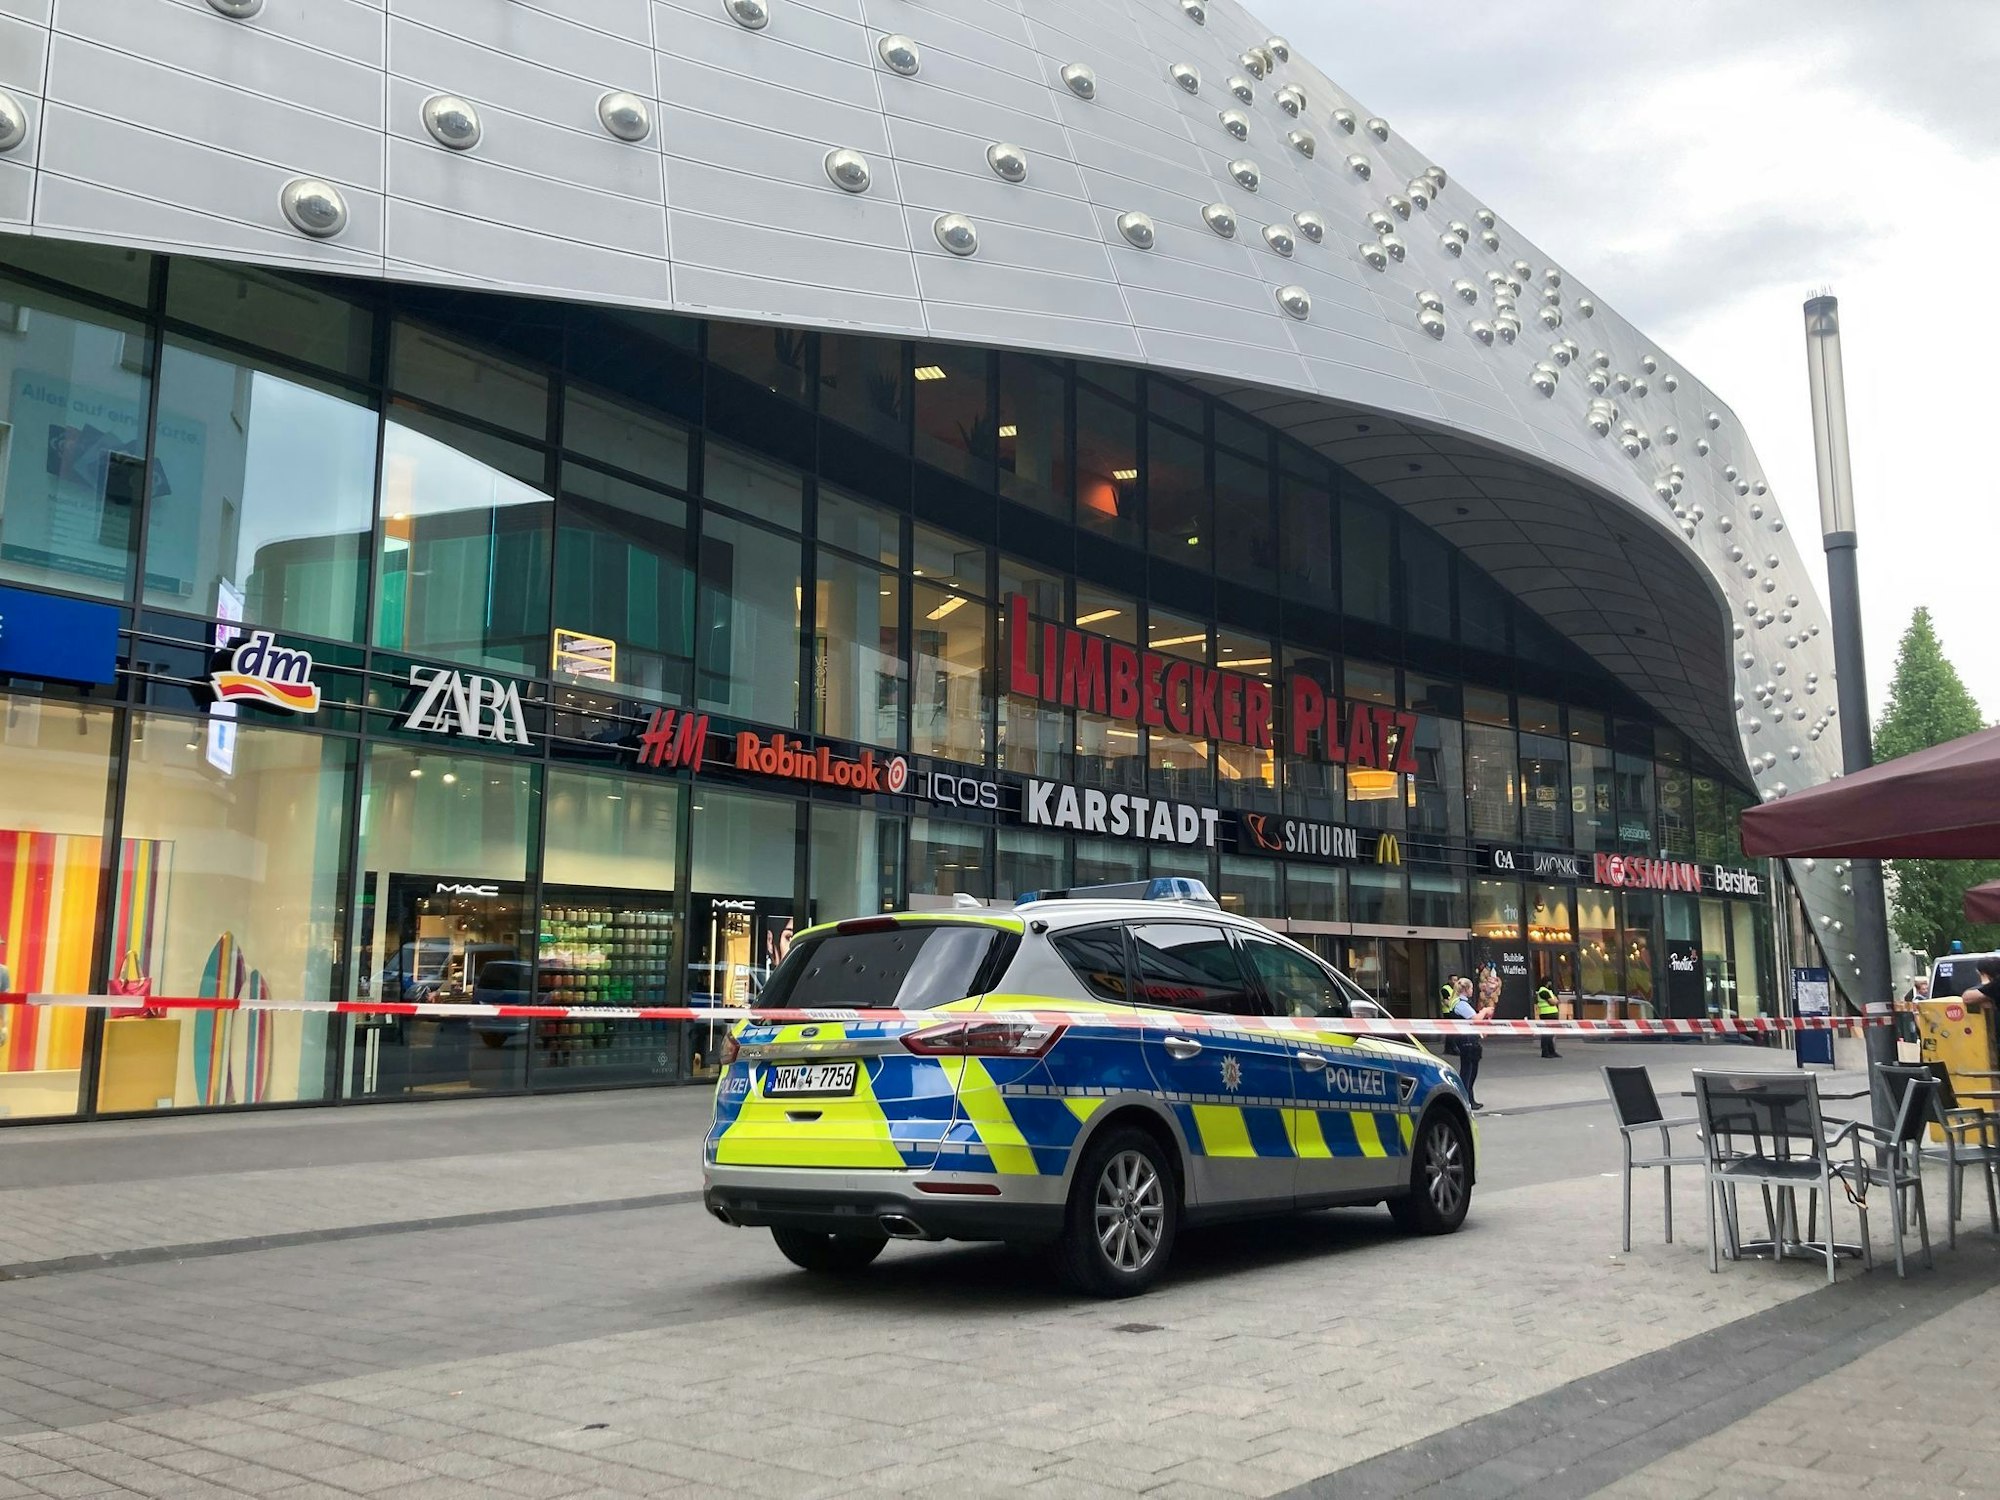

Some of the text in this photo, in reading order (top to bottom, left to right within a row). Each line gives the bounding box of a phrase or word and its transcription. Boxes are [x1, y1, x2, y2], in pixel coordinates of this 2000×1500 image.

[21, 382, 68, 409] Alles
[237, 635, 309, 683] dm
[1006, 593, 1419, 774] LIMBECKER PLATZ
[404, 664, 535, 746] ZARA
[638, 707, 709, 773] H&M
[736, 731, 881, 791] Robin Look
[927, 771, 998, 808] IQOS
[1027, 778, 1219, 847] KARSTADT
[1285, 819, 1357, 859] SATURN
[1593, 853, 1701, 892] ROSSMANN
[1715, 864, 1759, 895] Bershka
[1502, 965, 1527, 975] Waffeln
[1503, 952, 1525, 963] Bubble
[775, 1066, 802, 1090] NRW
[1325, 1066, 1387, 1096] POLIZEI
